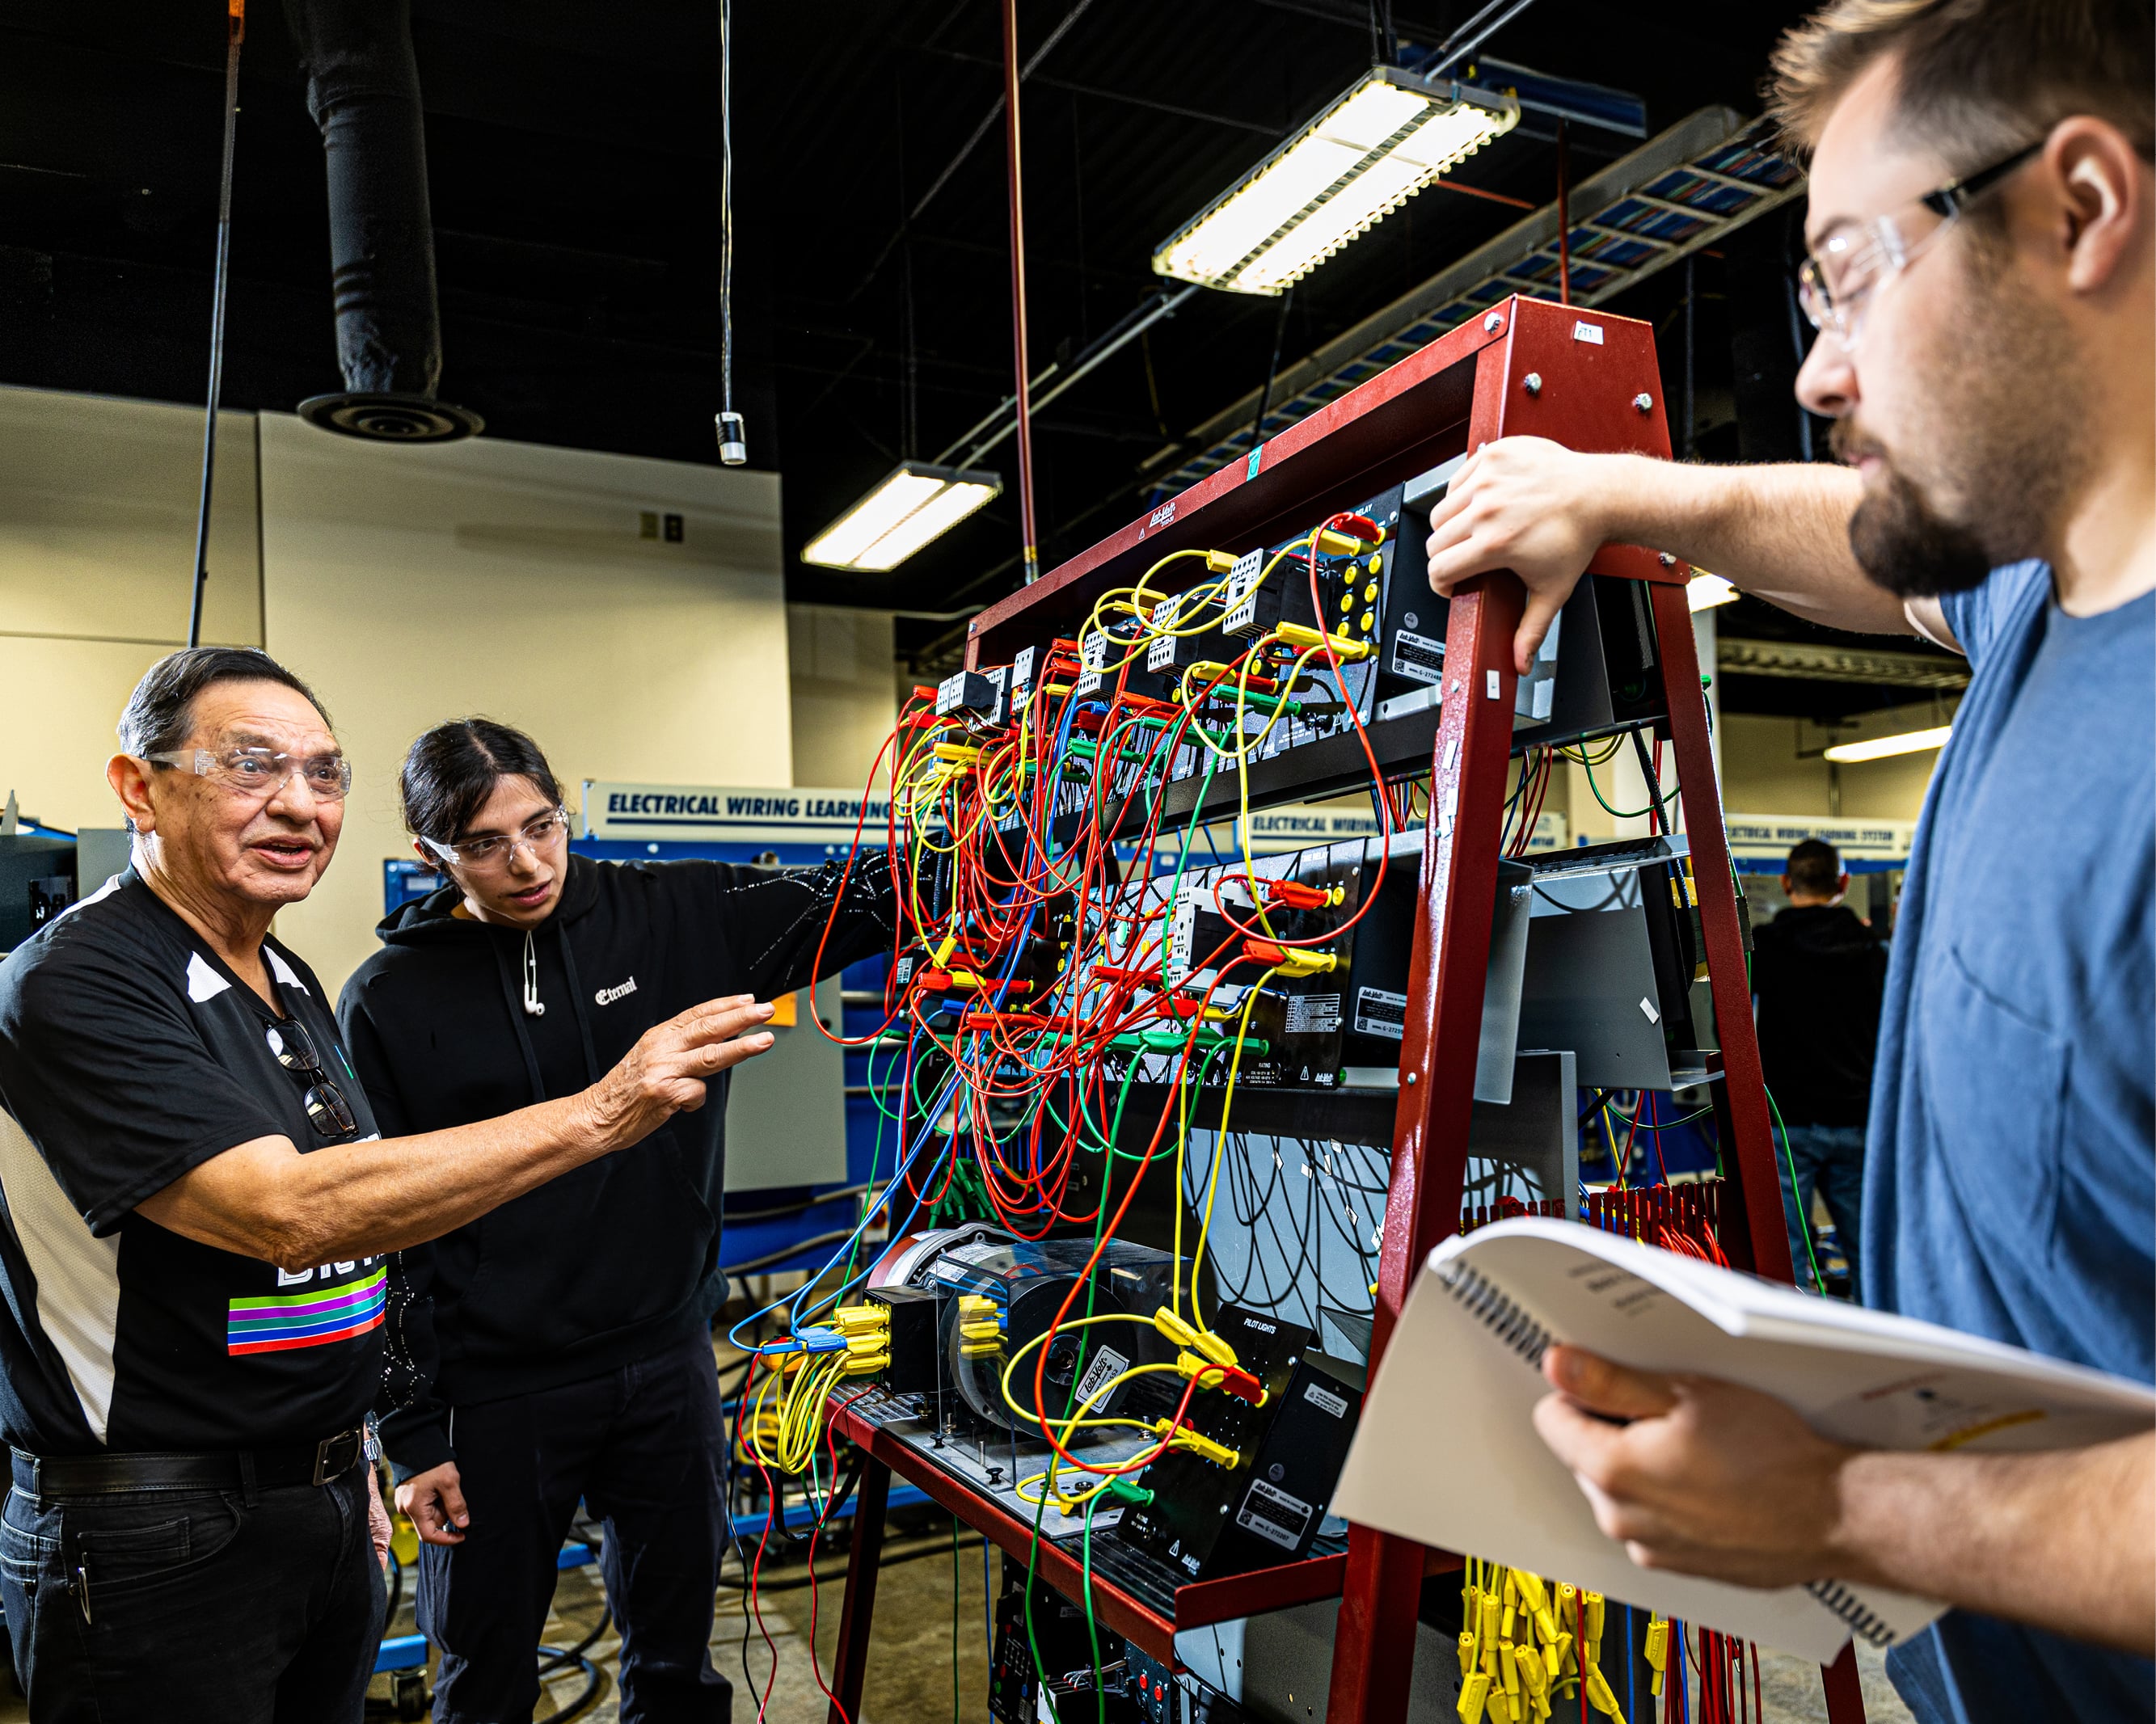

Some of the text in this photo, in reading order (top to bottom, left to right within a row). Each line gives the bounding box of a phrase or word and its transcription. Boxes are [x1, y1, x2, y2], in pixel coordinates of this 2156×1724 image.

[608, 792, 720, 816] ELECTRICAL
[727, 796, 800, 818] WIRING
[805, 799, 891, 820] LEARNING
[1253, 816, 1326, 832] ELECTRICAL
[1243, 1317, 1276, 1334] PILOT LIGHTS
[1084, 1358, 1107, 1393] Lab-Volt
